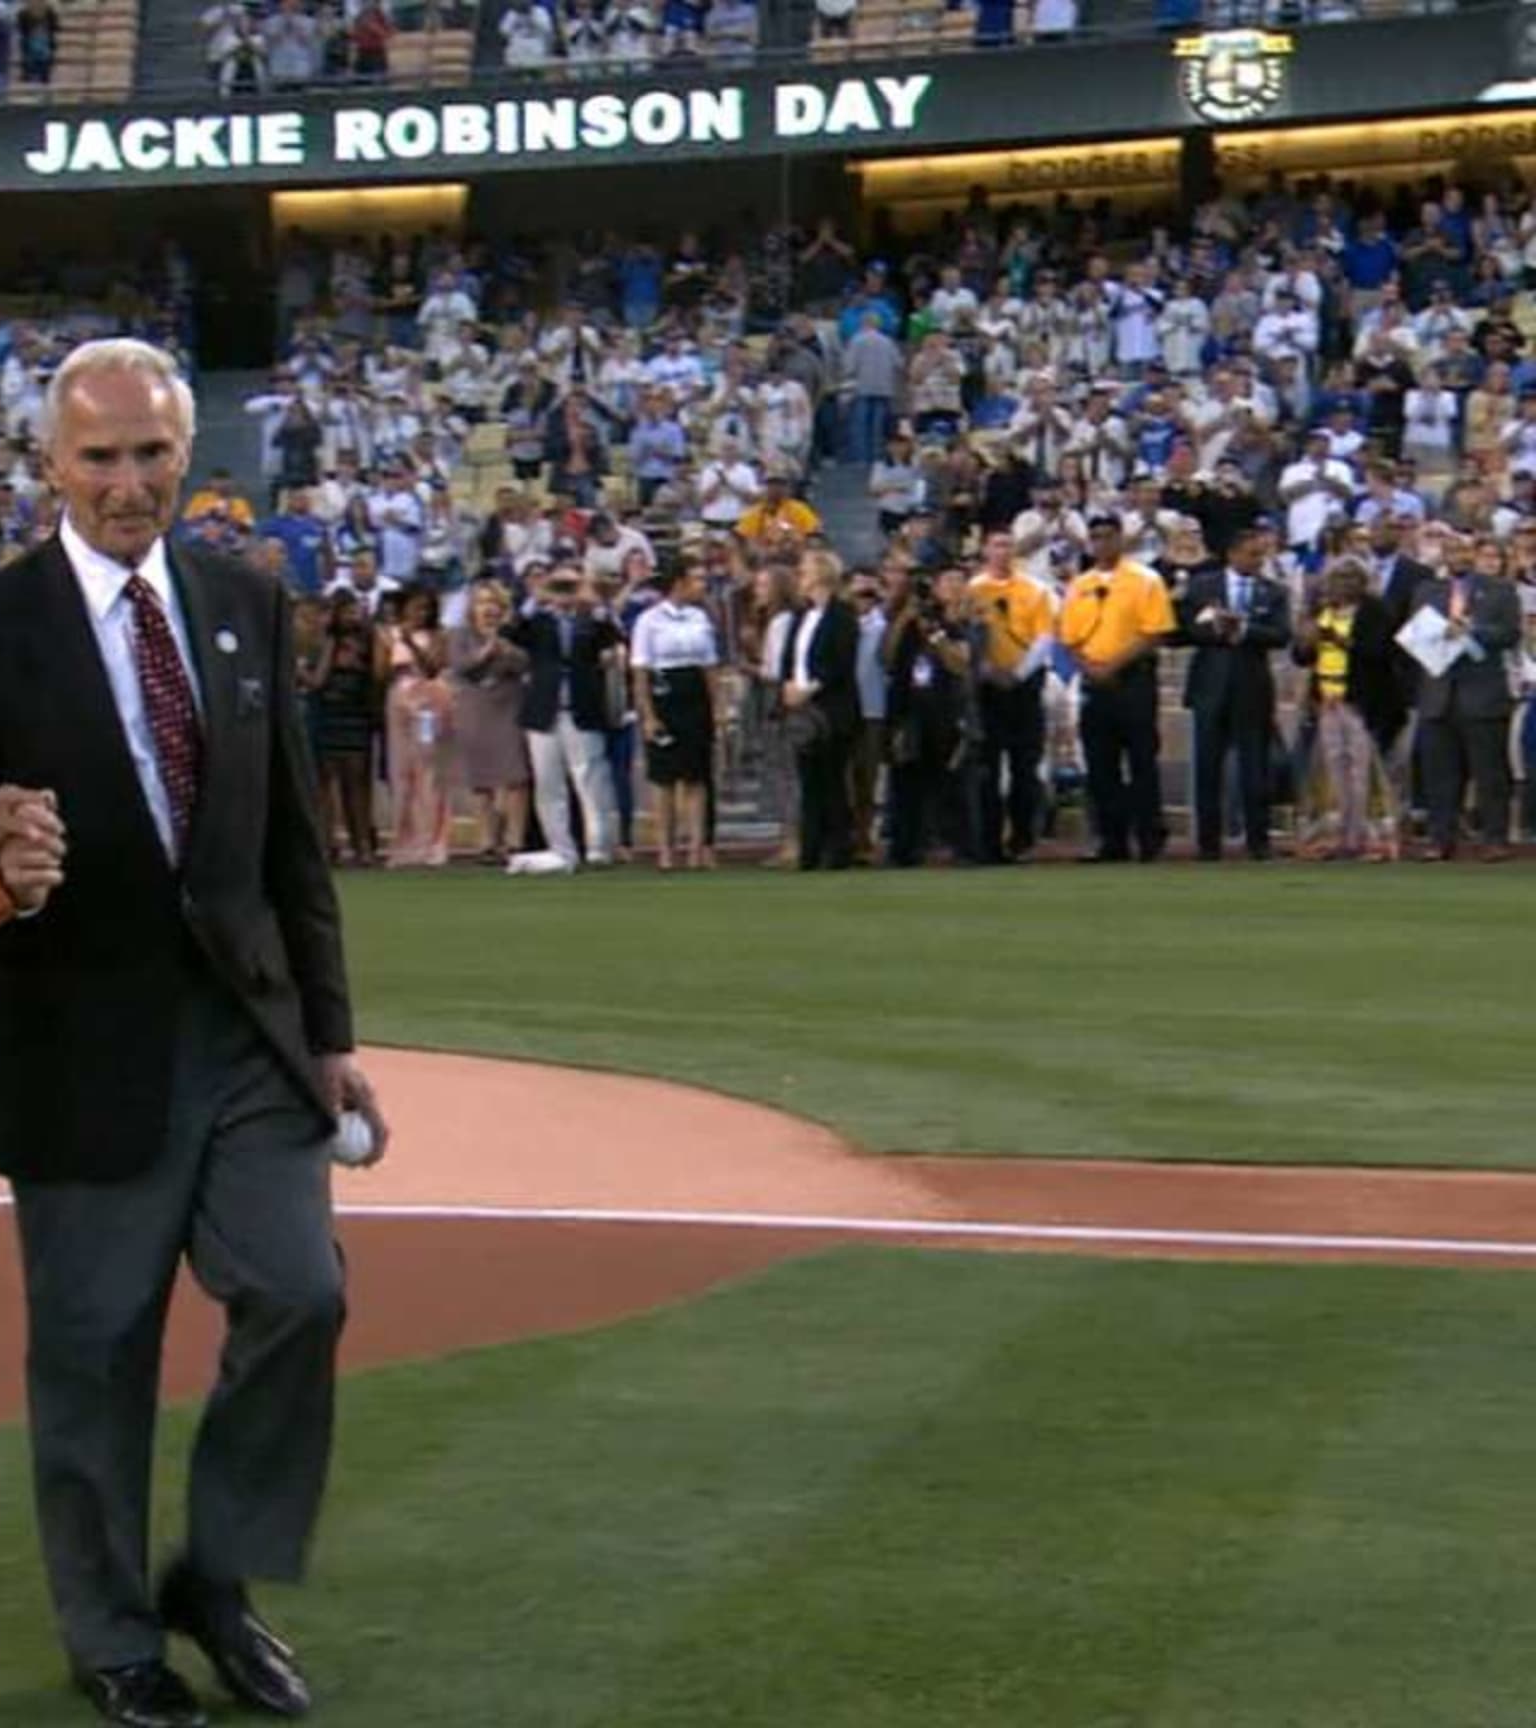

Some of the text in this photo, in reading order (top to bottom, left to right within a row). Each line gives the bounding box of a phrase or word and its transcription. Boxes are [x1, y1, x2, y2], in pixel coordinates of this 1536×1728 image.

[26, 76, 930, 173] JACKIE ROBINSON DAY
